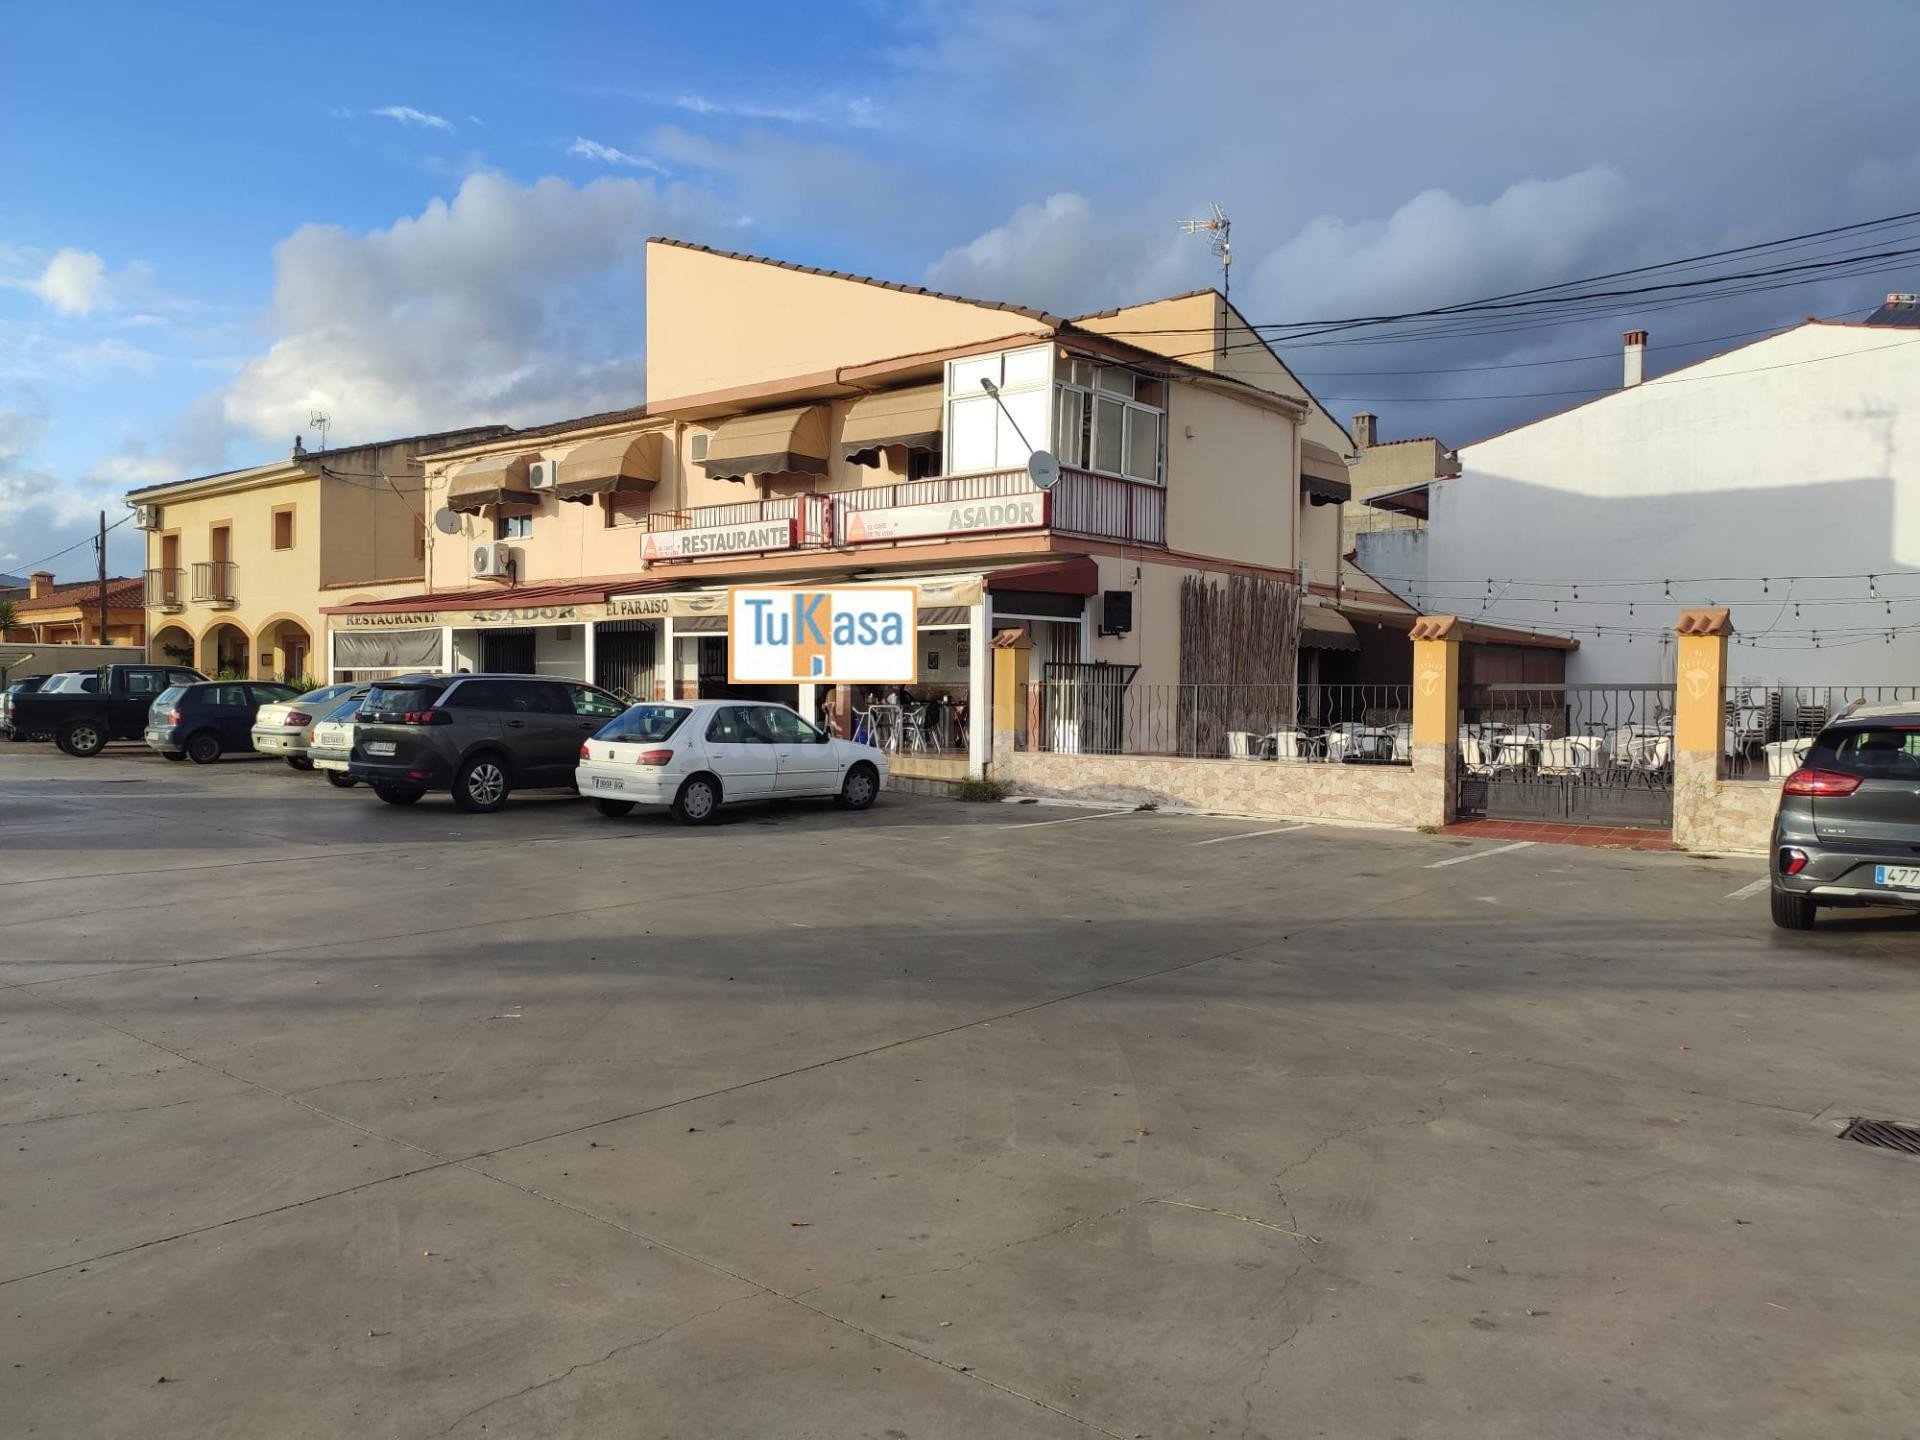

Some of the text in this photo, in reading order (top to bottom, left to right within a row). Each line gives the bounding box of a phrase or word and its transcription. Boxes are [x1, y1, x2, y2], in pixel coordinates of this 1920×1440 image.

[948, 501, 1035, 531] ASADOR
[681, 526, 789, 555] RESTAURANTE
[471, 605, 576, 622] ASADOR
[606, 602, 619, 616] EL
